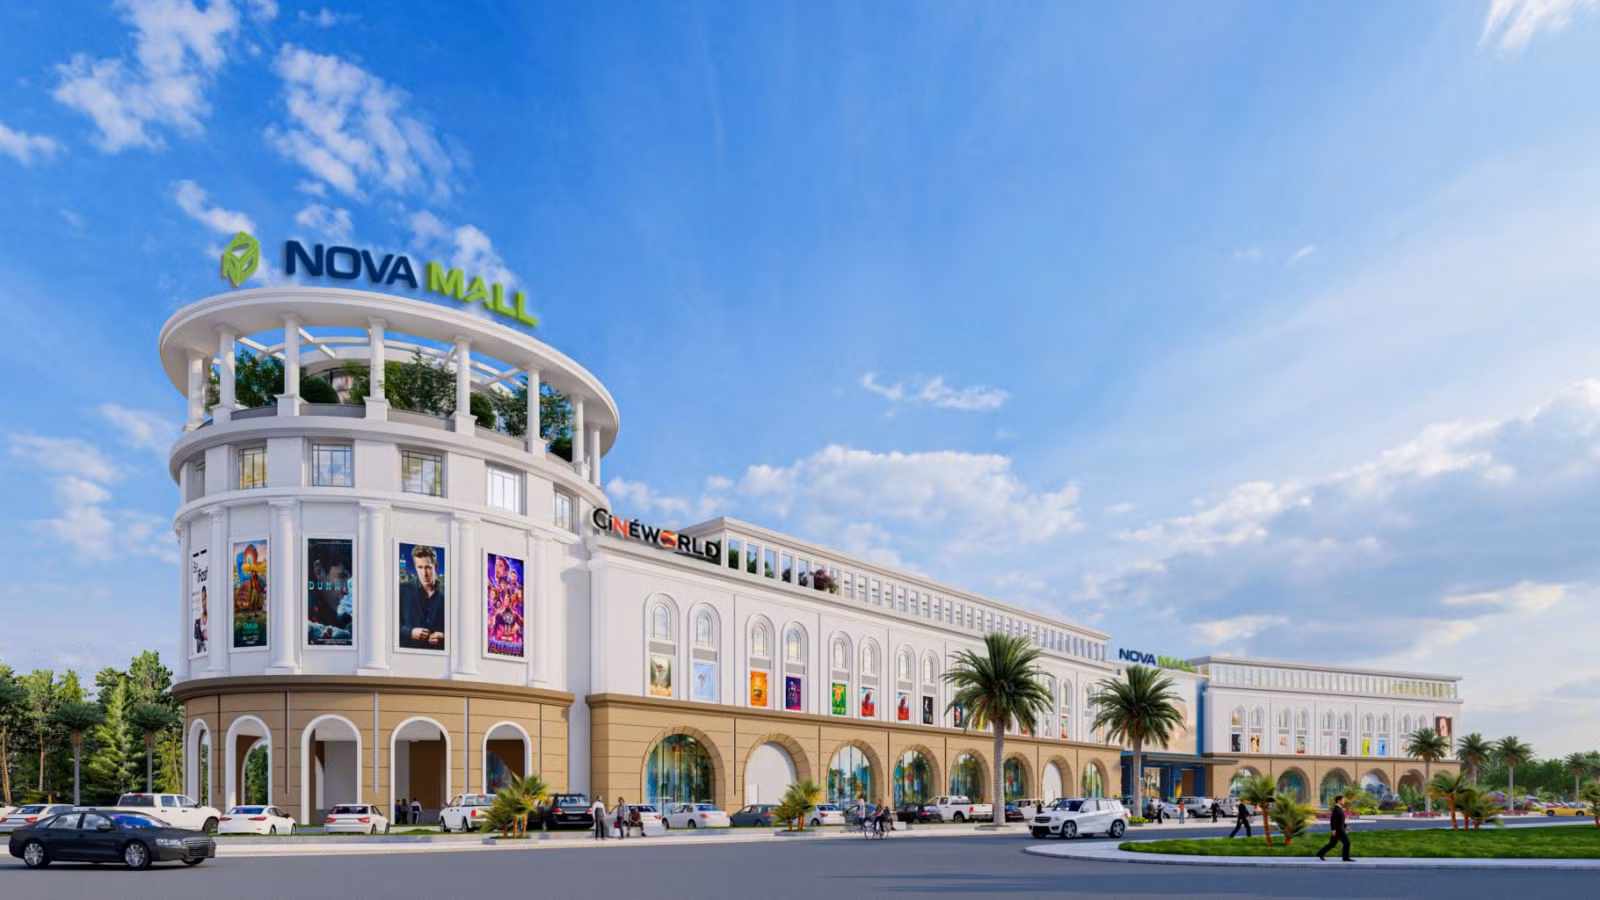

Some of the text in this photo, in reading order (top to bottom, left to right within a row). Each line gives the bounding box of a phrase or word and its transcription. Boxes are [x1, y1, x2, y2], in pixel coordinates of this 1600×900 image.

[285, 240, 538, 327] NOVA MALL
[1119, 647, 1197, 673] NOVA MALL
